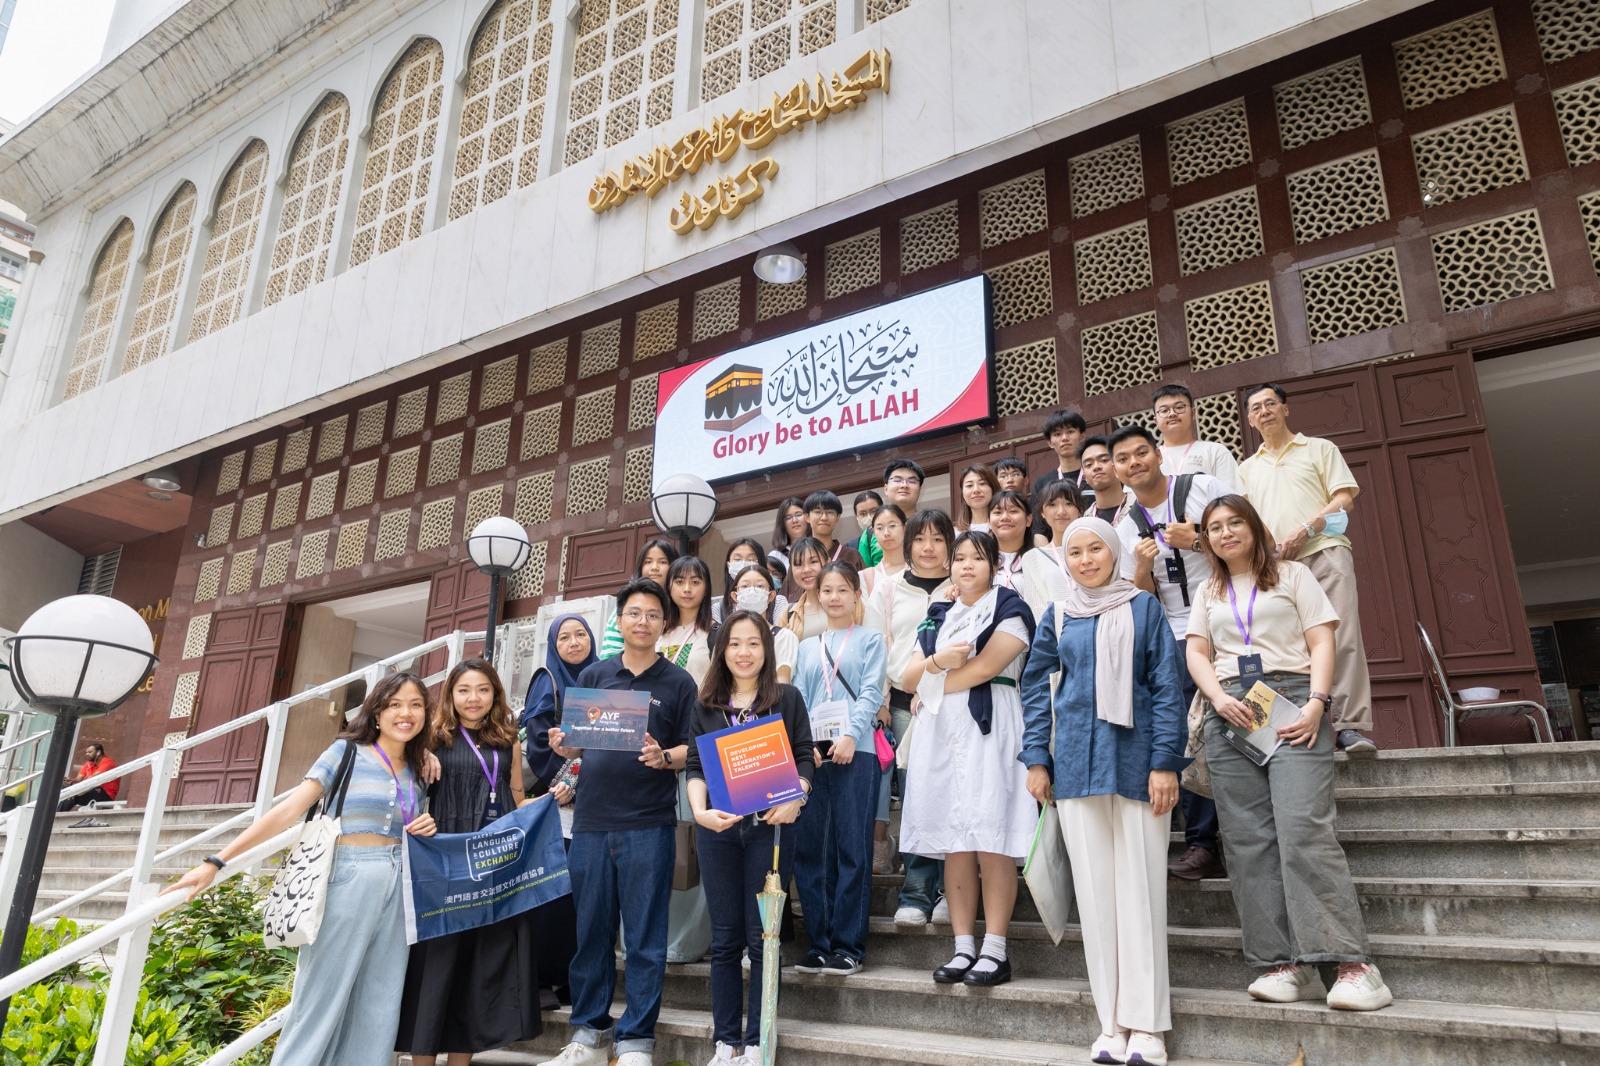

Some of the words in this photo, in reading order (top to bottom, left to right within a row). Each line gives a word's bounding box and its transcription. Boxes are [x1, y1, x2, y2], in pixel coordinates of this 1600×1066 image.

[713, 432, 770, 459] Glory
[775, 422, 802, 445] be
[808, 416, 832, 437] to
[838, 388, 919, 430] ALLAH
[600, 711, 620, 720] AYF
[730, 742, 768, 757] DEVELOPING
[731, 754, 746, 762] NEXT
[734, 761, 760, 773] TALENTS
[472, 833, 518, 850] LANGUAGE
[478, 841, 519, 858] CULTURE
[475, 850, 518, 869] EXCHANGE
